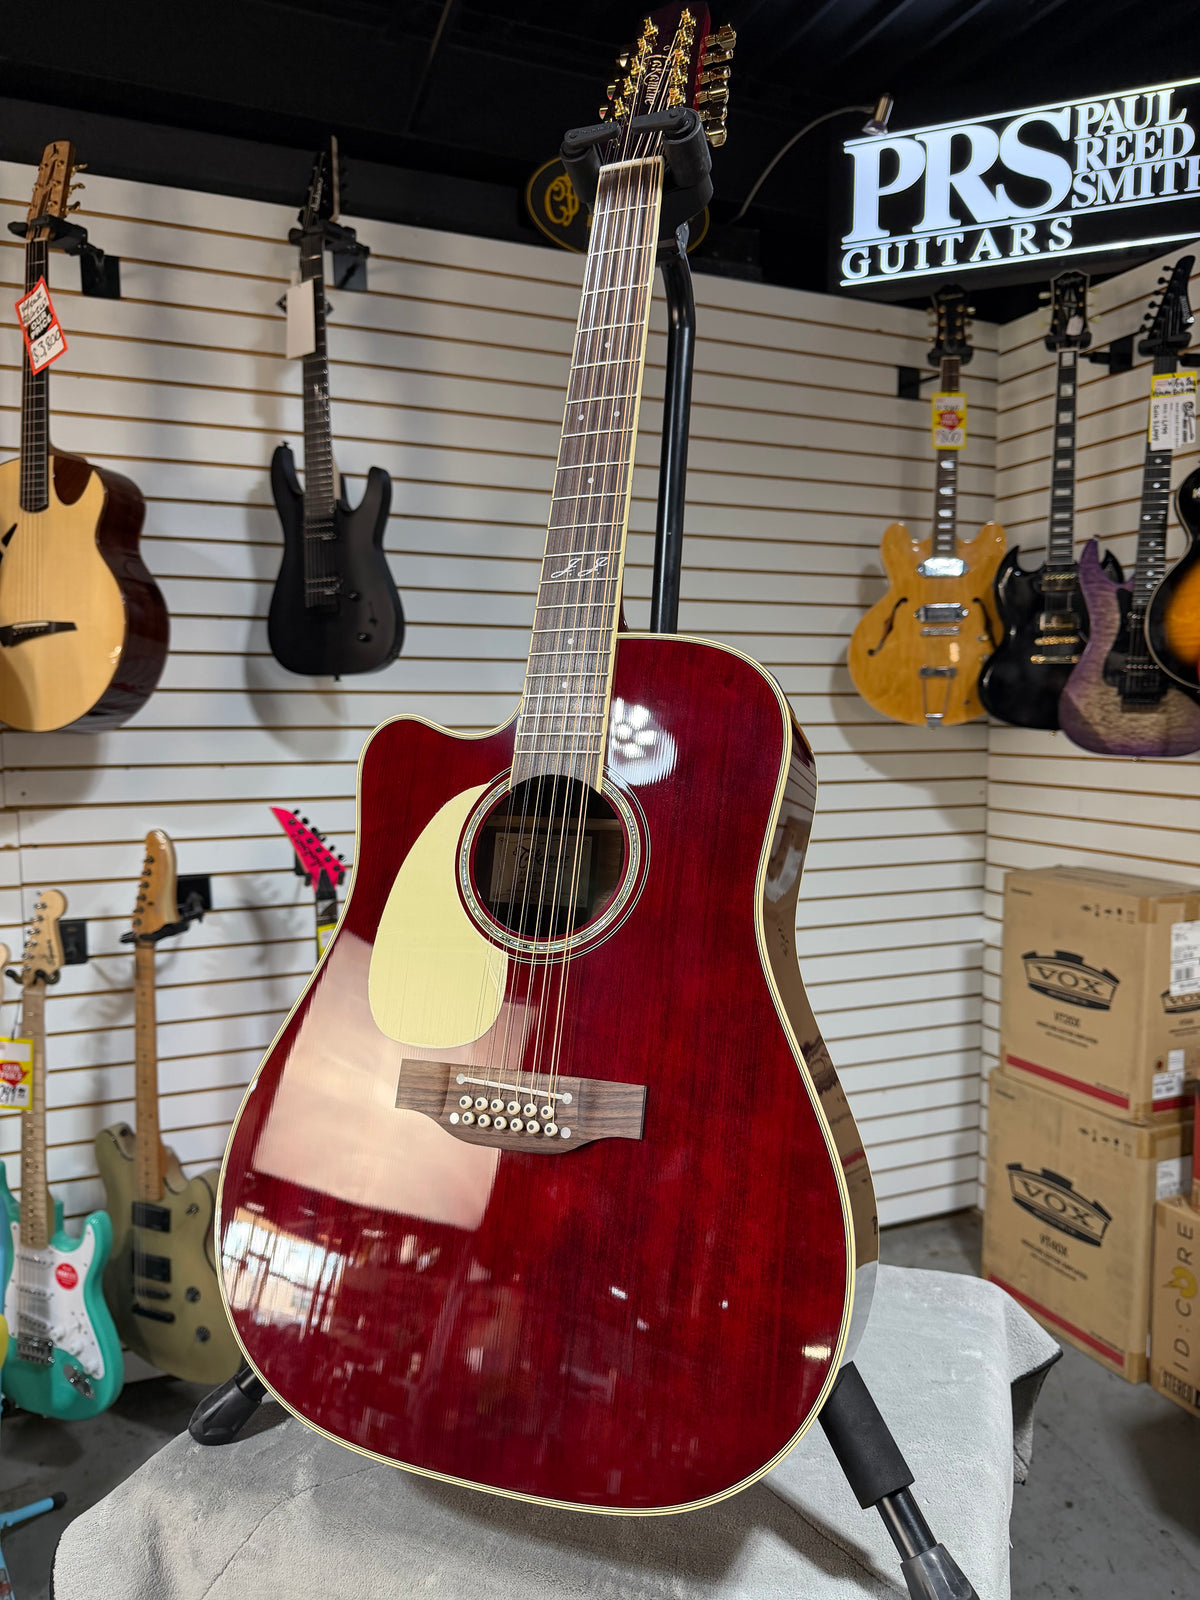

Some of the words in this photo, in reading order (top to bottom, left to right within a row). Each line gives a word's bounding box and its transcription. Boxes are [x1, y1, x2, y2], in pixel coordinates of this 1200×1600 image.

[1074, 89, 1188, 140] PAUL
[1073, 122, 1196, 175] REED
[842, 107, 1073, 244] PRS
[841, 217, 1073, 279] GUITARS
[30, 313, 53, 340] PRICE
[31, 311, 48, 330] OUR
[1034, 965, 1105, 997] VOX
[1018, 1178, 1095, 1231] VOX
